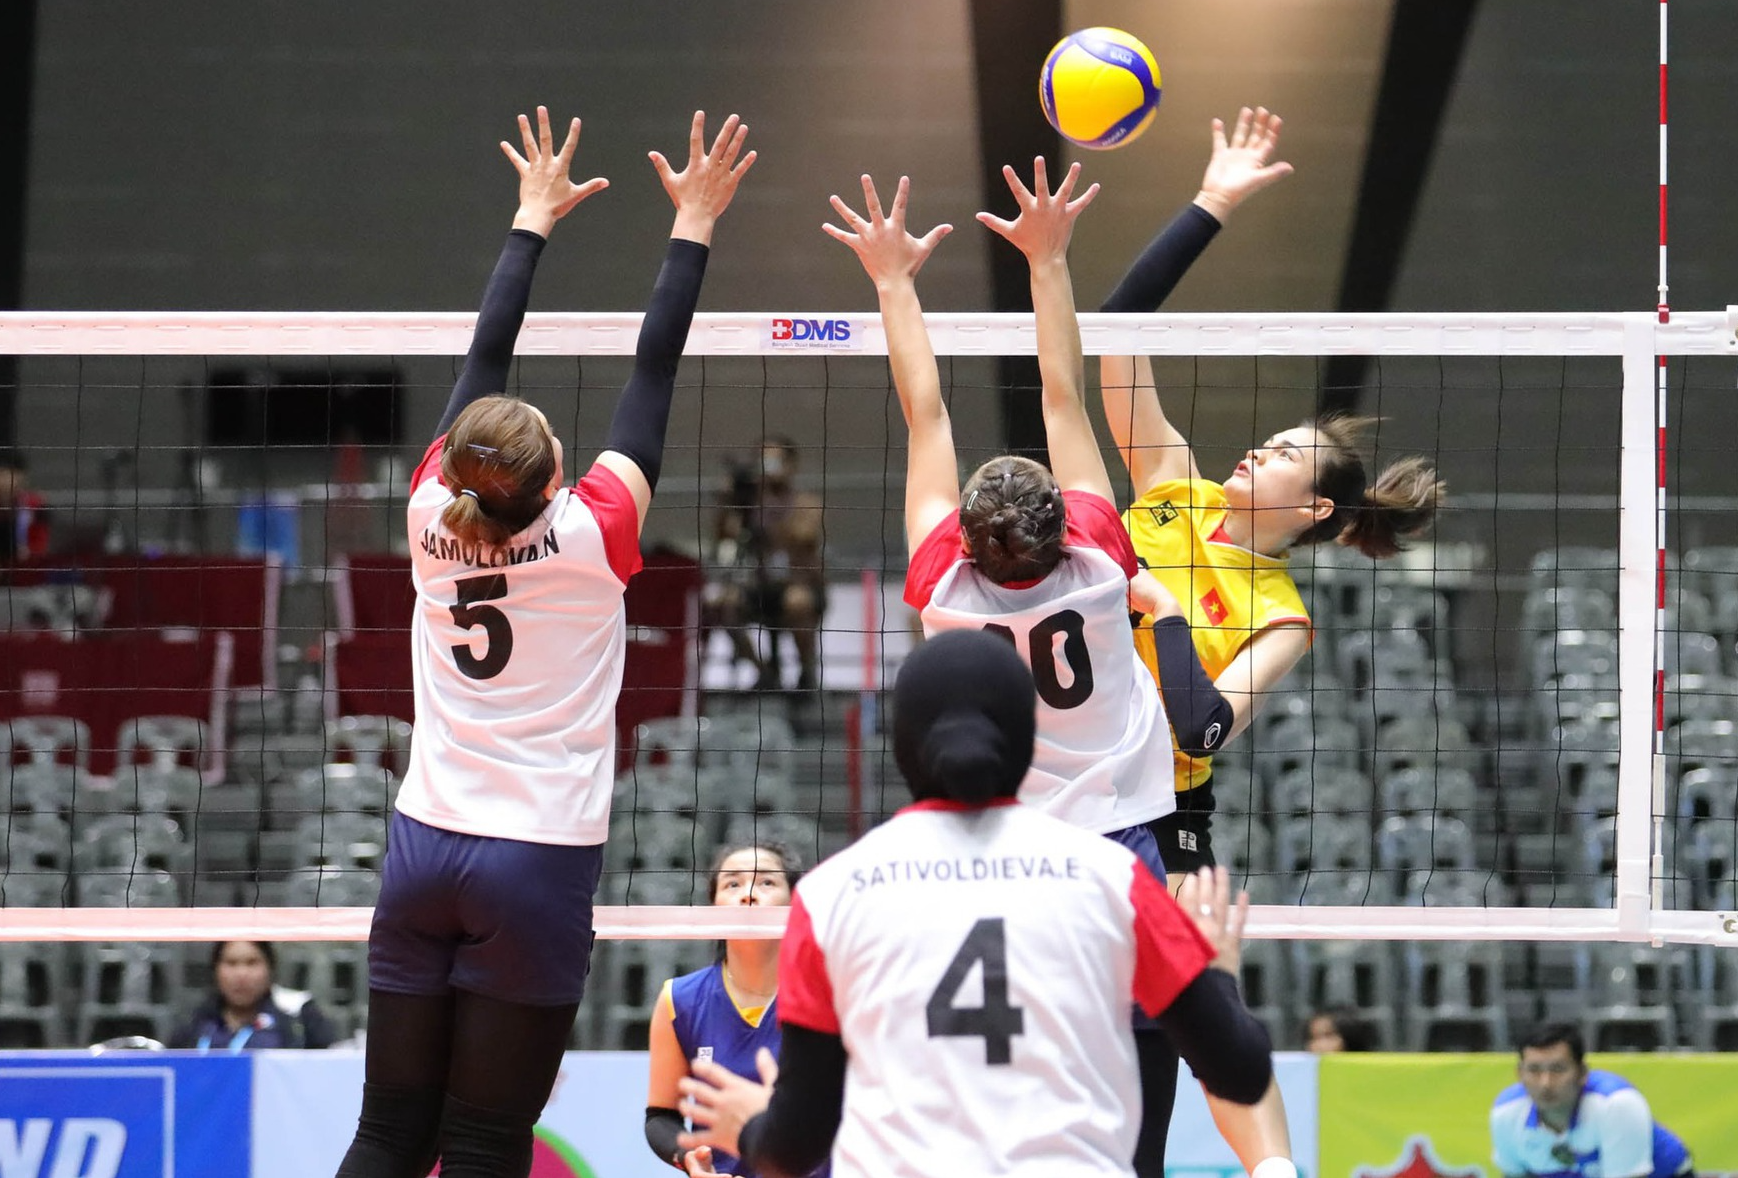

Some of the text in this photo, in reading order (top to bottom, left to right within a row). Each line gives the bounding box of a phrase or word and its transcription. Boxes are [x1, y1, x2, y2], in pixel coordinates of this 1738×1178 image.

[772, 319, 851, 341] BDMS
[448, 573, 514, 680] 5
[926, 917, 1025, 1066] 4
